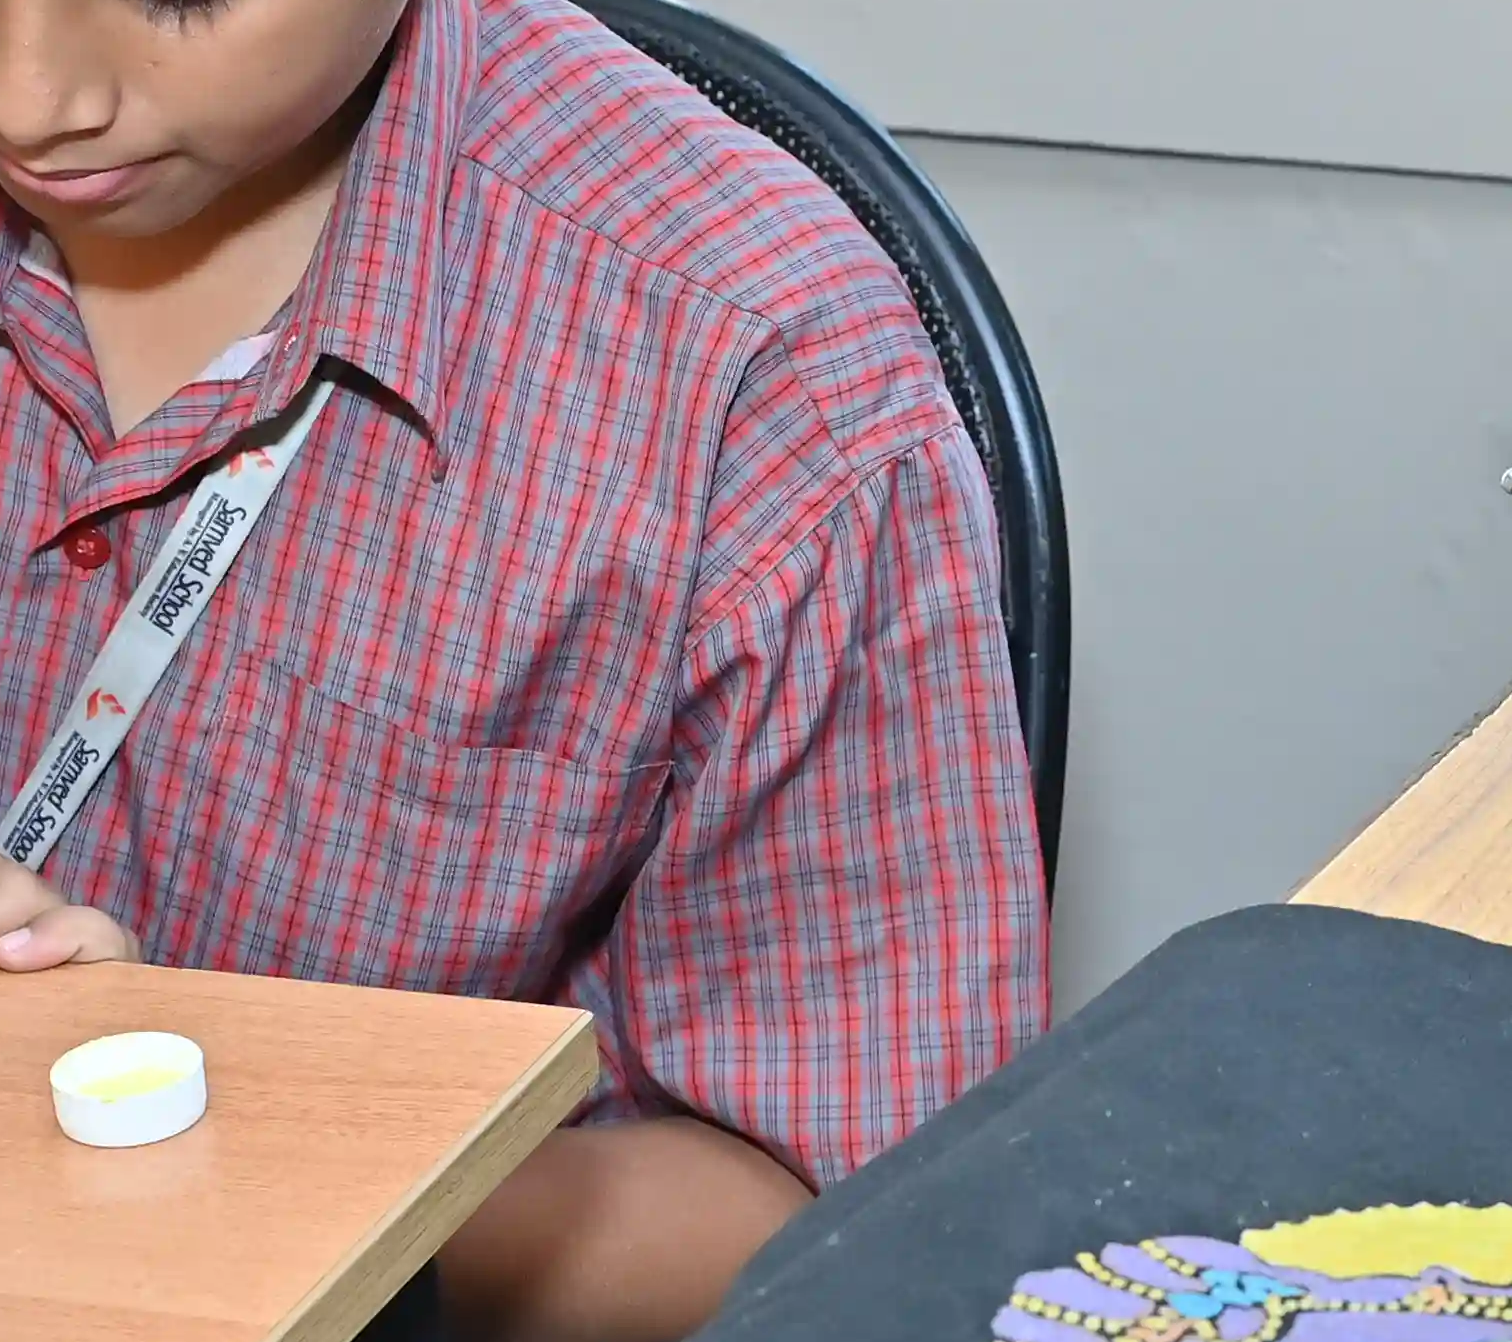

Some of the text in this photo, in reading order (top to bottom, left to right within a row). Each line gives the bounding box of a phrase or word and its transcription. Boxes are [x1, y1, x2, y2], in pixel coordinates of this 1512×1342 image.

[152, 499, 247, 637] Samved School
[47, 739, 100, 814] Samved
